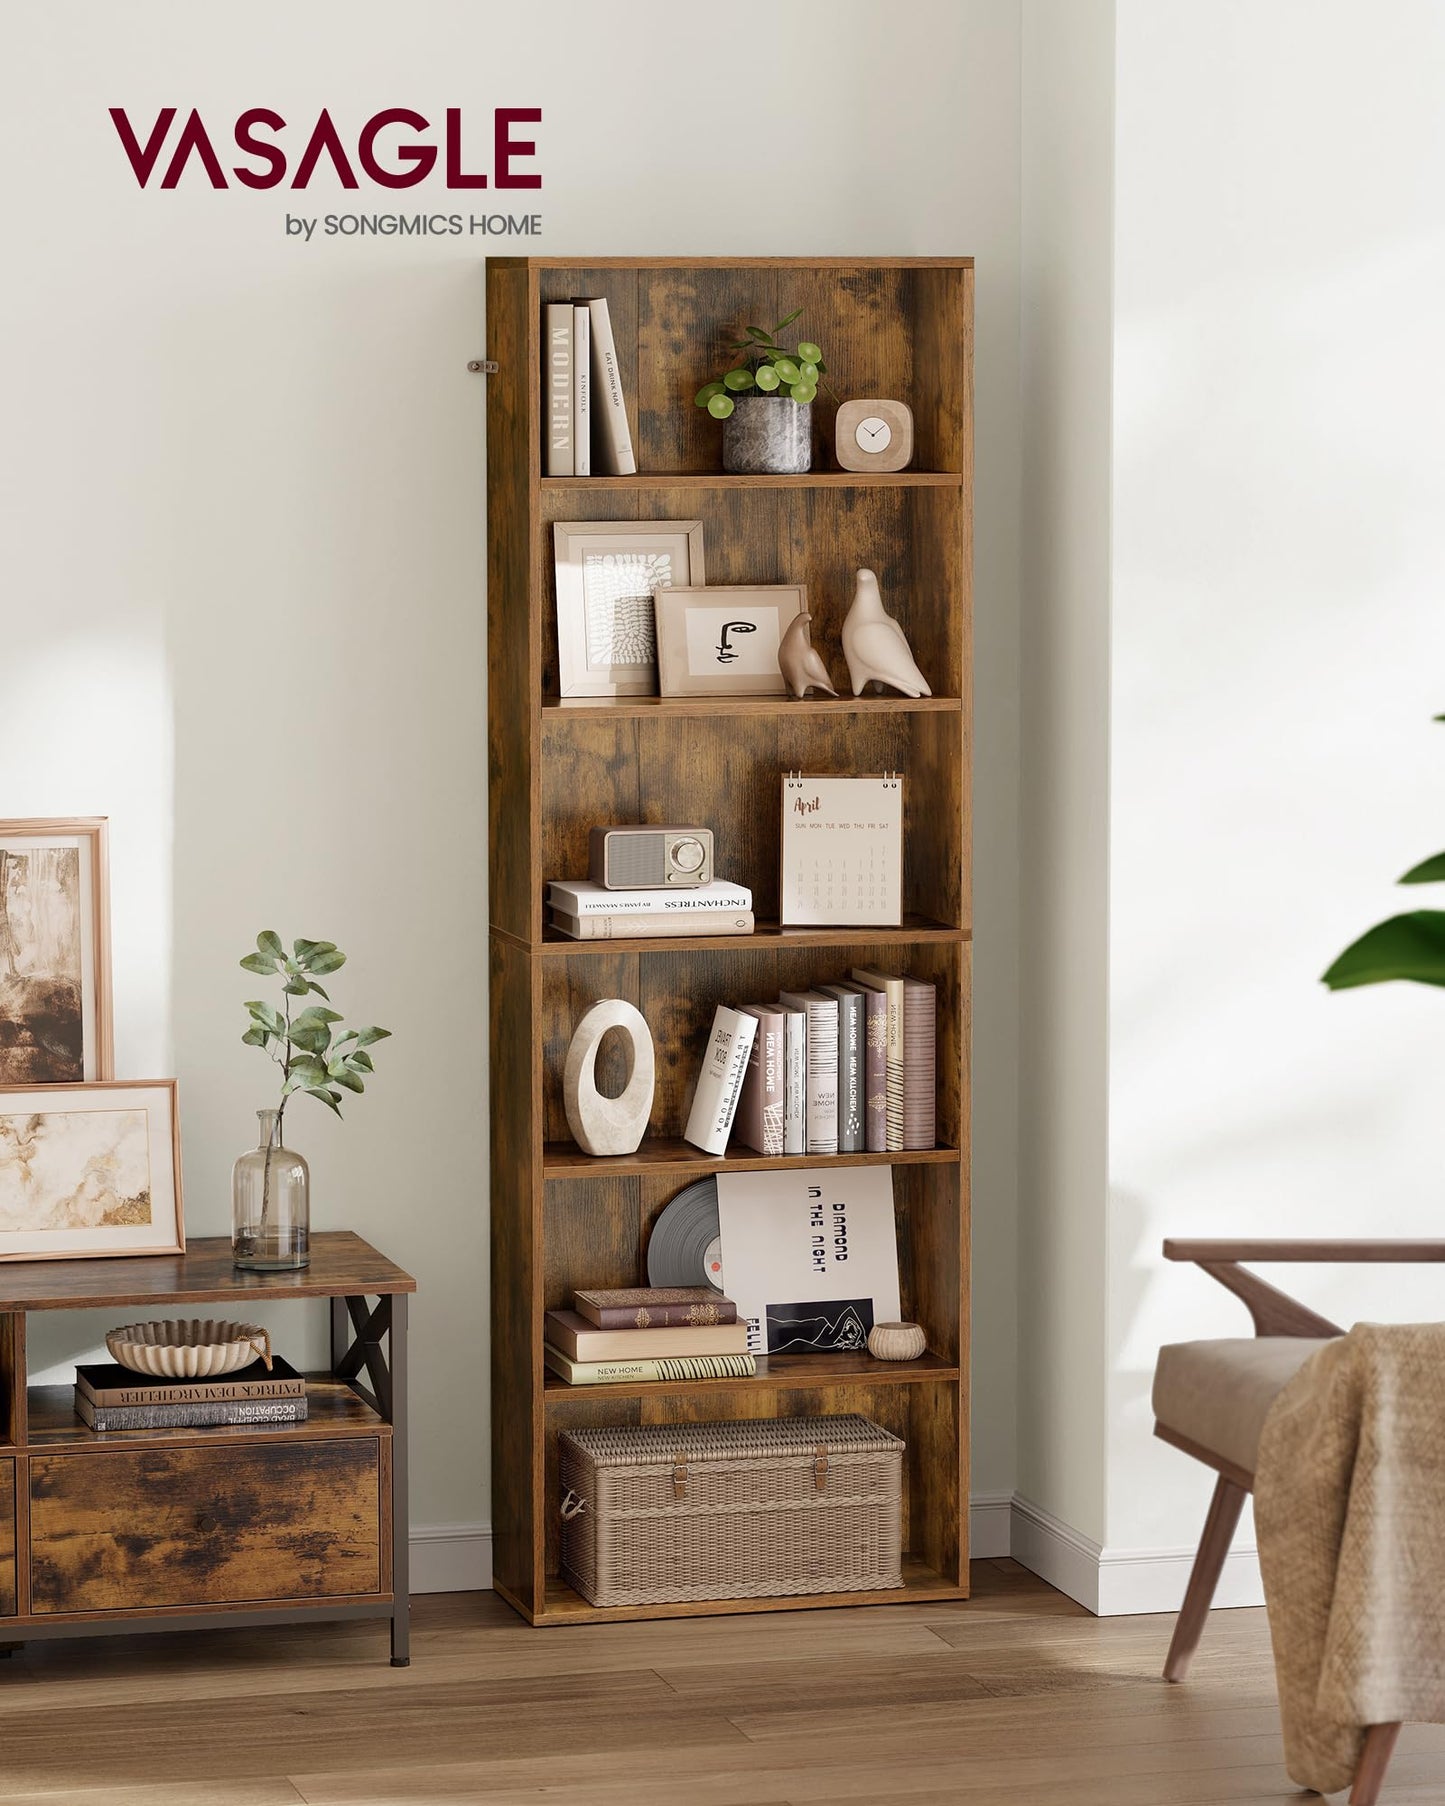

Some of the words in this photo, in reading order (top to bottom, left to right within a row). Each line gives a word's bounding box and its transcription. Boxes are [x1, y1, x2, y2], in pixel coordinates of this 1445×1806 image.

[607, 367, 616, 391] DRINK
[552, 327, 569, 449] MODERN
[794, 796, 821, 816] April
[664, 898, 746, 909] ENCHANTRESS
[810, 1204, 824, 1227] THE
[618, 1366, 644, 1374] HOME
[120, 1386, 236, 1403] DEMARCHELIER
[242, 1383, 302, 1396] PATRICK
[239, 1405, 296, 1416] OCCUPATION
